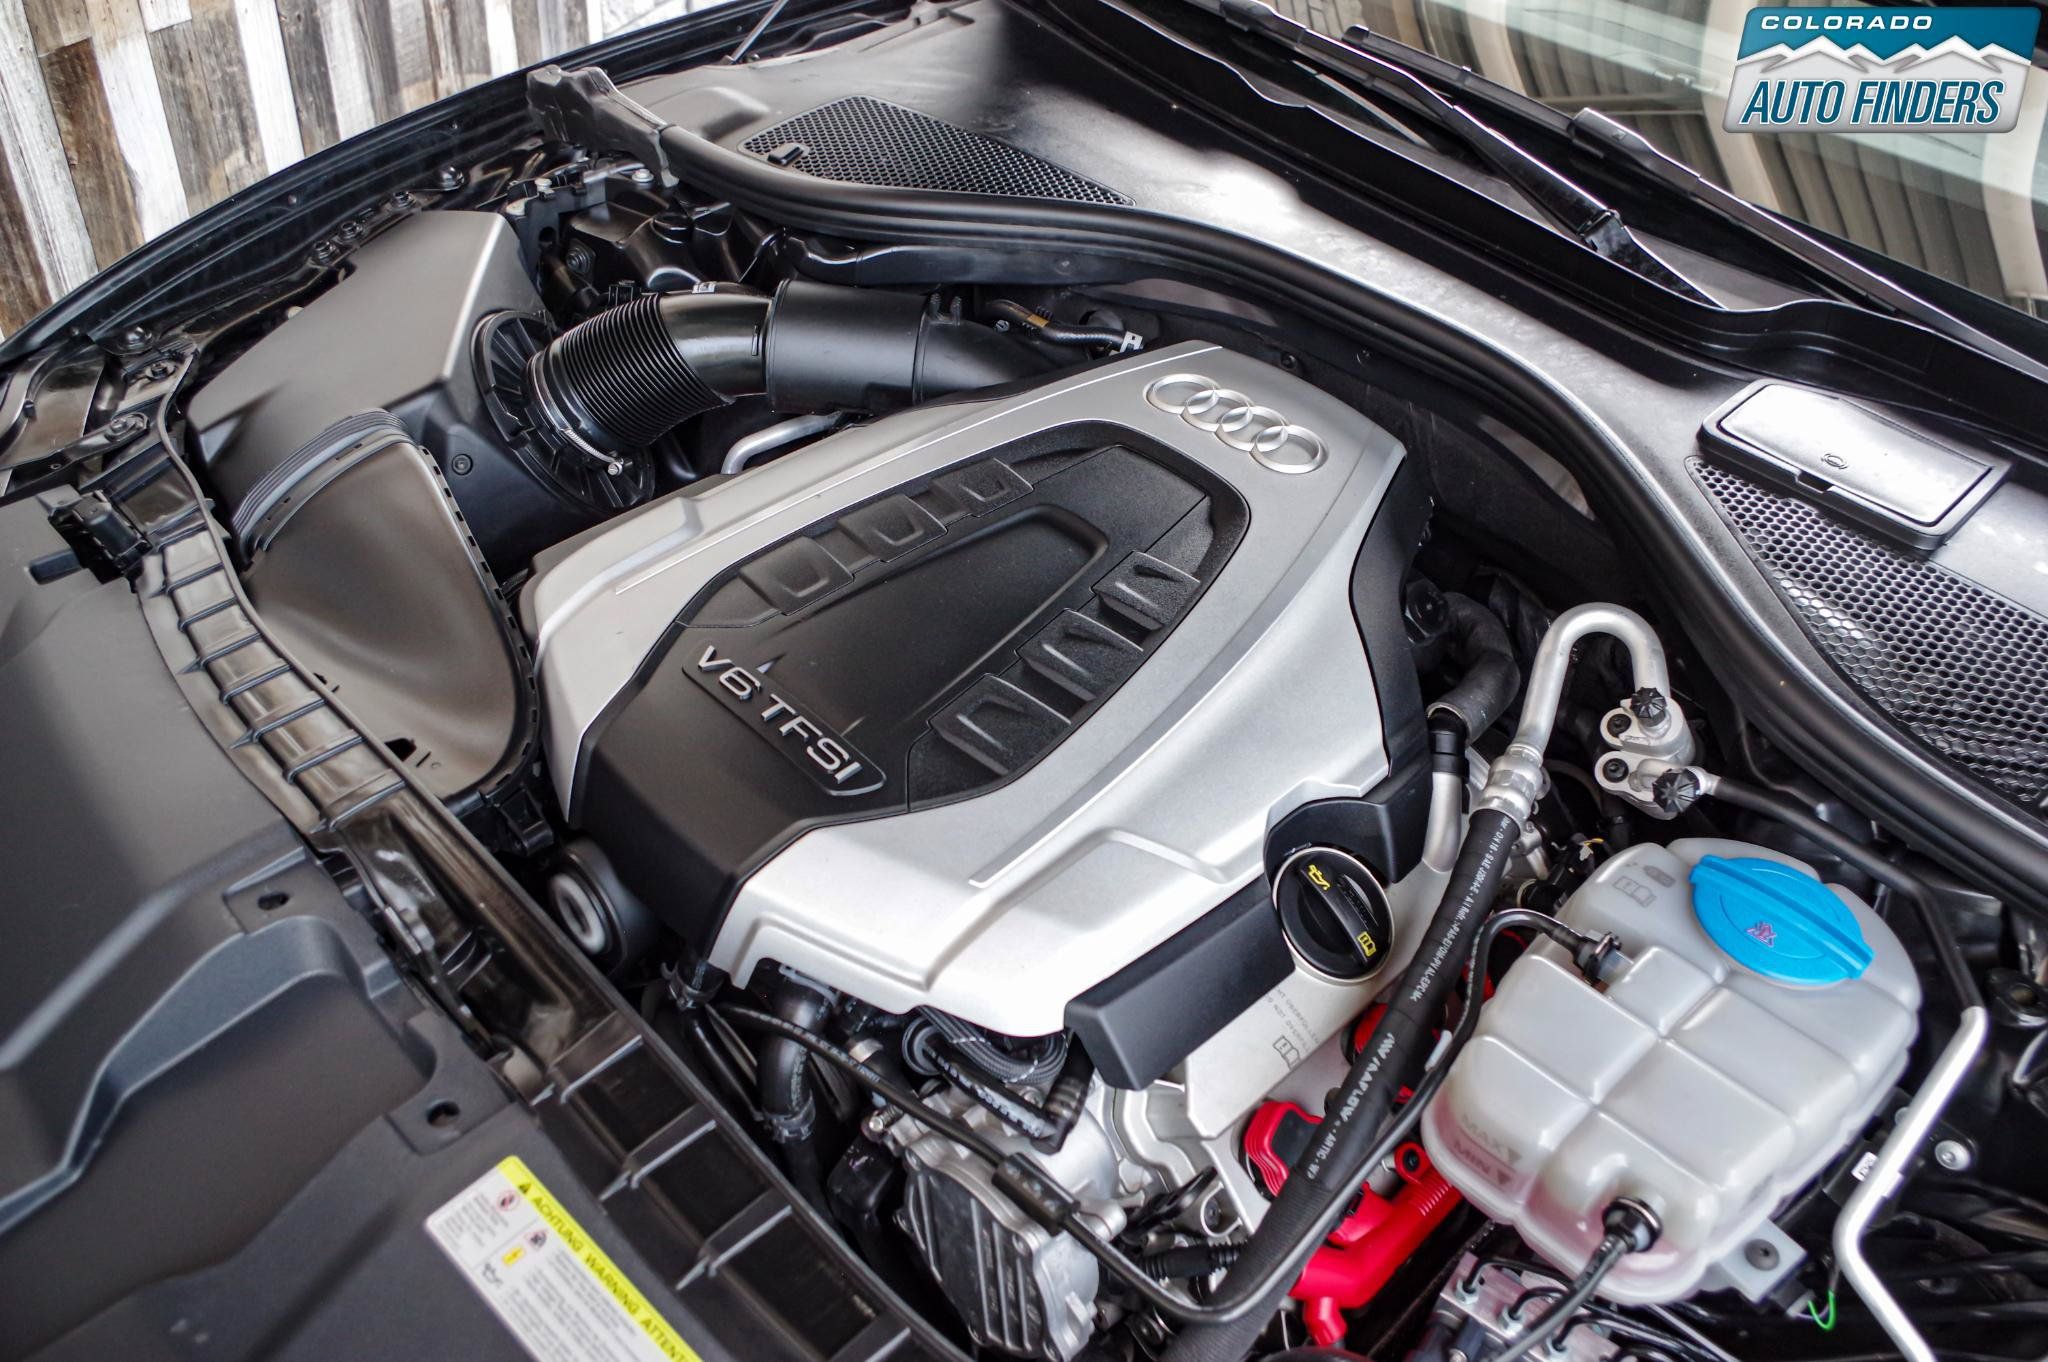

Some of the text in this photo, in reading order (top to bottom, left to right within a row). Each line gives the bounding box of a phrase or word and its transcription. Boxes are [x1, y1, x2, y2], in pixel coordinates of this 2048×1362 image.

[698, 645, 864, 785] V6 TFSI
[533, 1197, 584, 1251] ACHTUNG
[585, 1253, 640, 1315] WARNING
